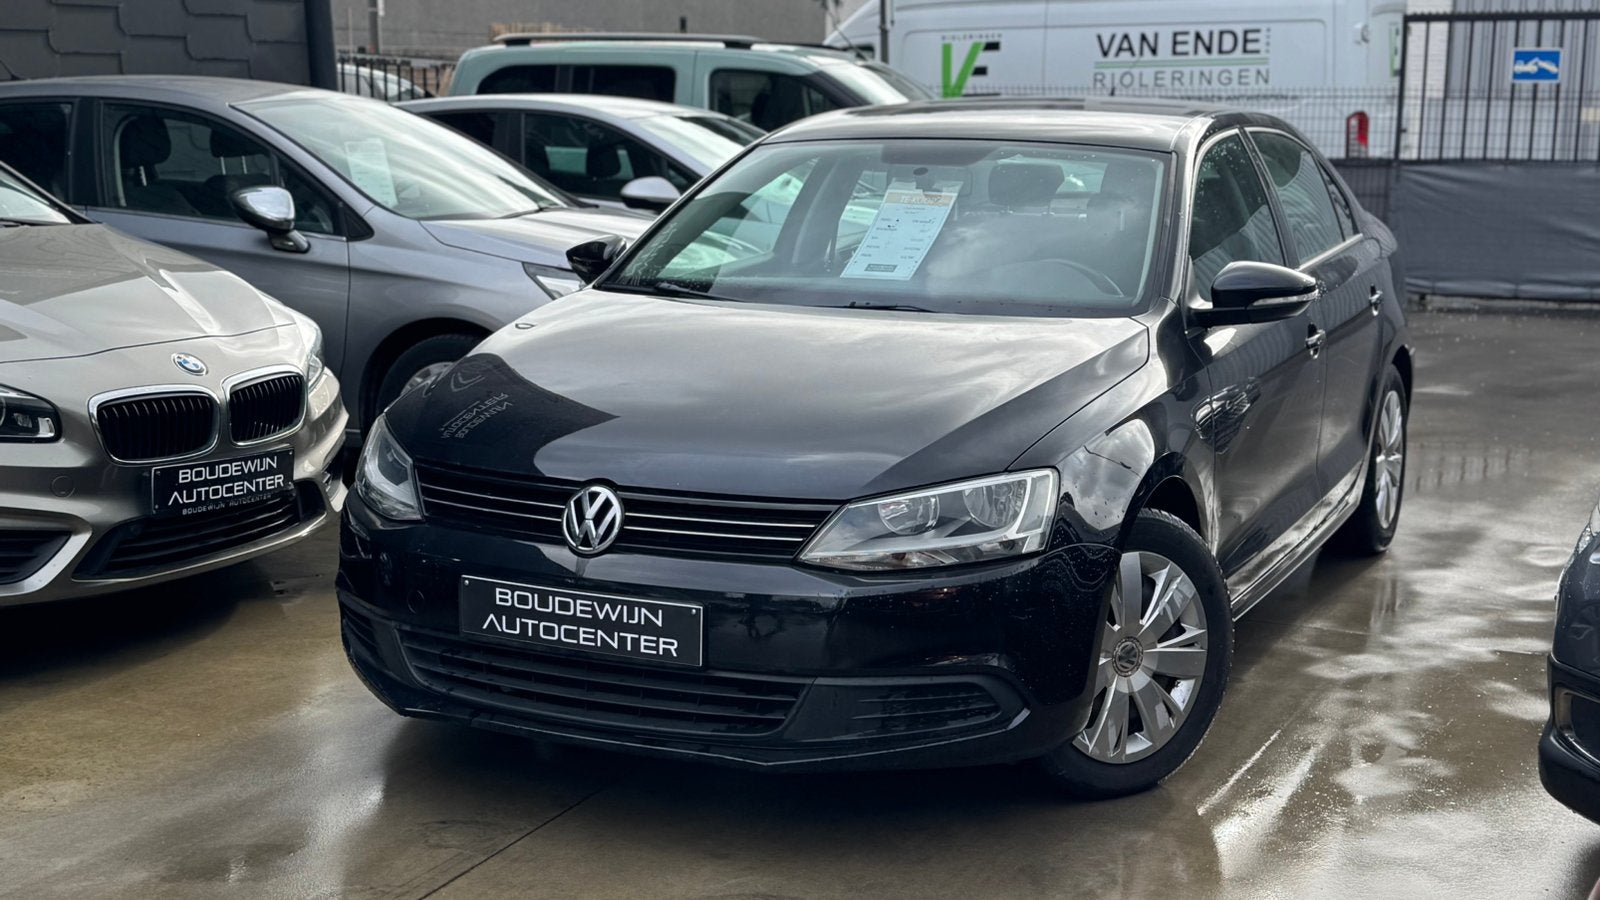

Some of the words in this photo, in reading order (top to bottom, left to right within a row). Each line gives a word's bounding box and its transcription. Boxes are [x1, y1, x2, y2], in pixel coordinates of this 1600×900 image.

[1096, 32, 1159, 58] VAN
[1171, 29, 1262, 56] ENDE
[1093, 68, 1271, 89] RIOLERINGEN
[178, 456, 278, 484] BOUDEWIJN
[167, 474, 285, 506] AUTOCENTER
[495, 587, 663, 628] BOUDEWIJN
[482, 613, 679, 658] AUTOCENTER
